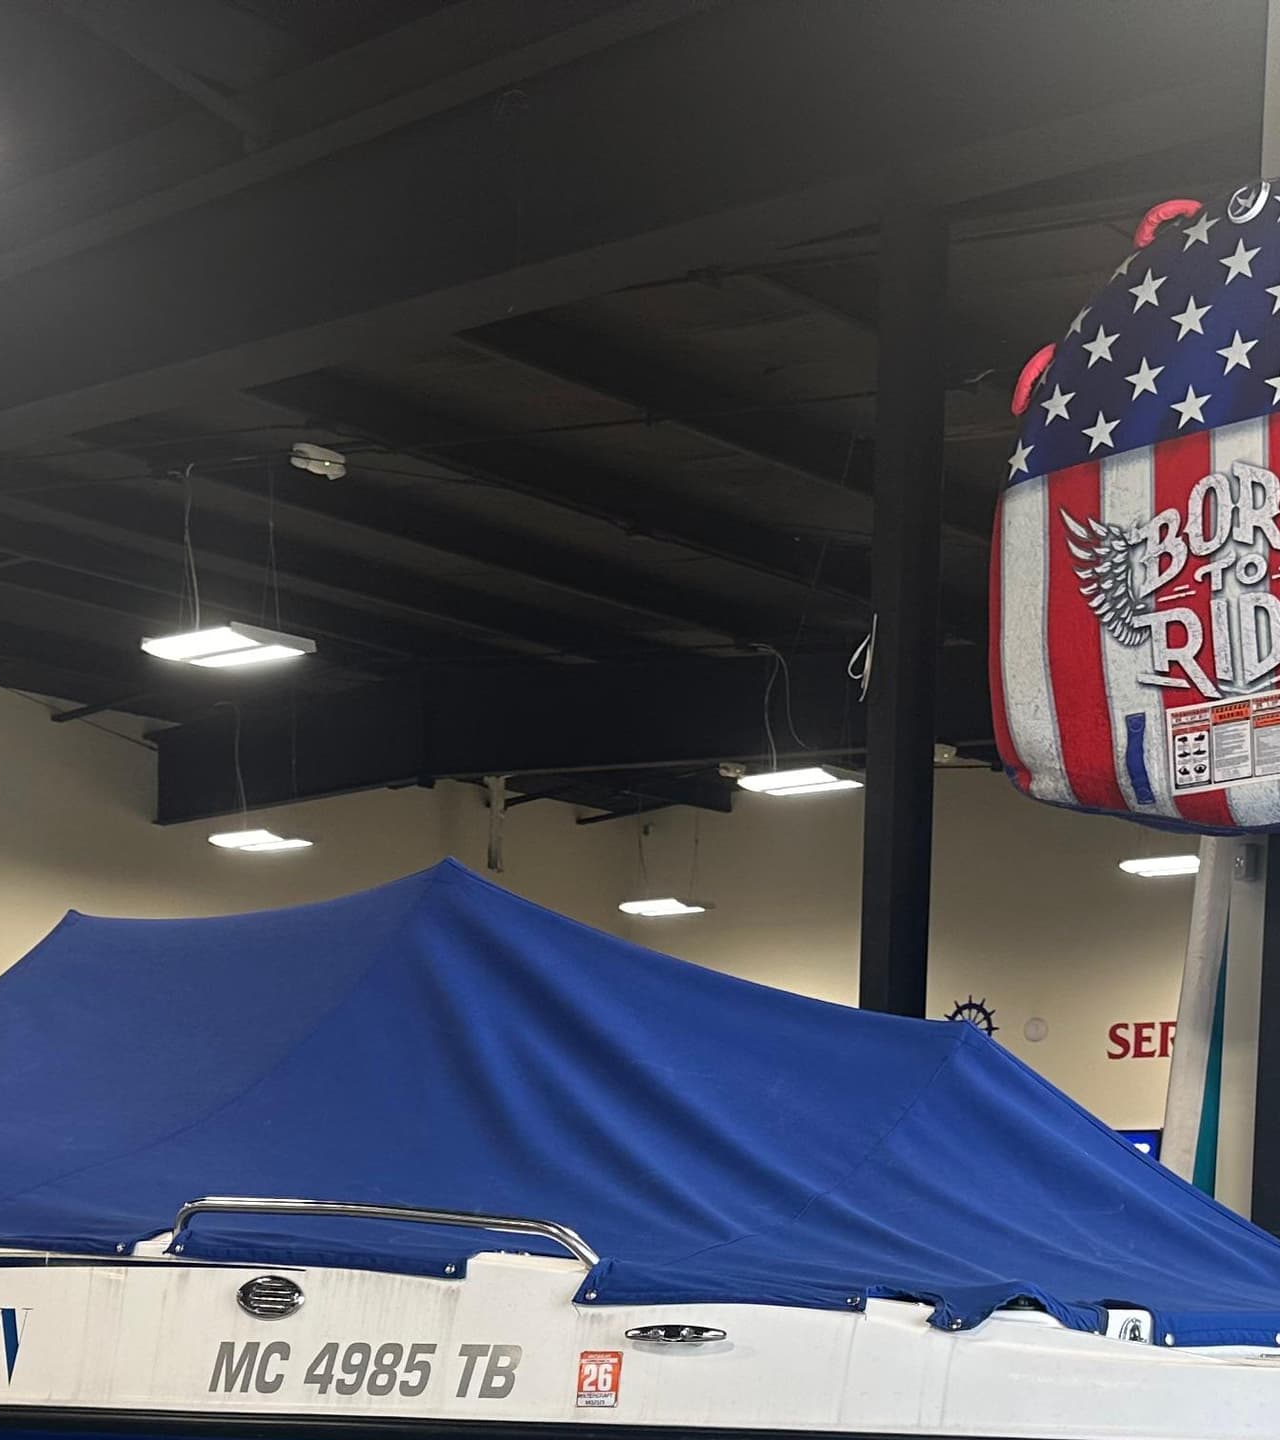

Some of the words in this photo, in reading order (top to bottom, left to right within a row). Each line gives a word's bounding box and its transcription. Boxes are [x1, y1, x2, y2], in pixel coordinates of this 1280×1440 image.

[1193, 551, 1268, 592] TO
[208, 1341, 291, 1394] MC
[303, 1342, 438, 1397] 4985
[455, 1343, 523, 1399] TB
[582, 1363, 614, 1391] 26
